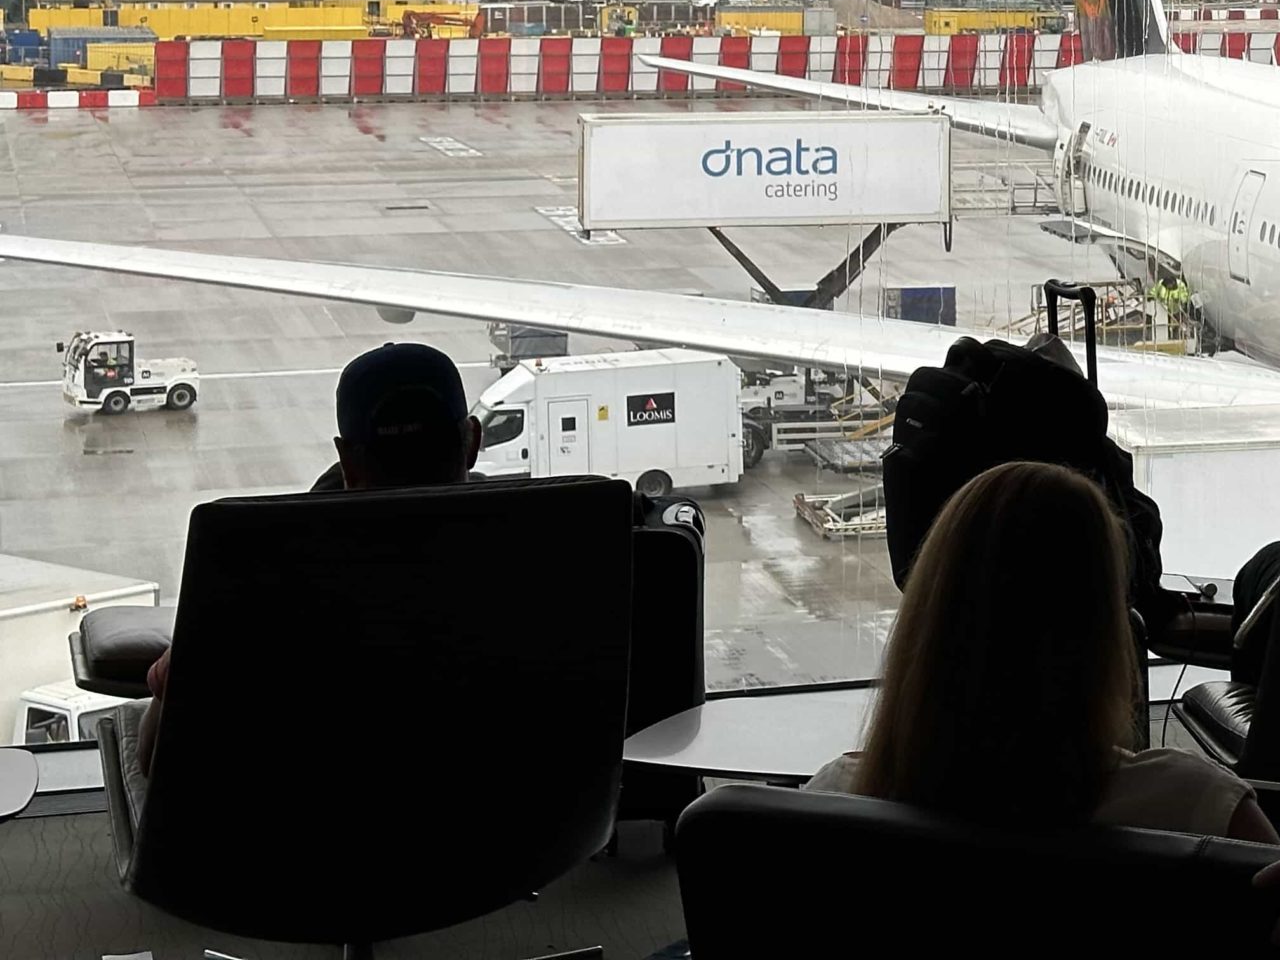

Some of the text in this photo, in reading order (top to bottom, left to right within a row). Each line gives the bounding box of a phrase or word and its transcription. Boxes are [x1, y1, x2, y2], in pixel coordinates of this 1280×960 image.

[701, 138, 839, 177] dnata
[764, 179, 839, 201] catering
[629, 409, 673, 423] LOOMIS
